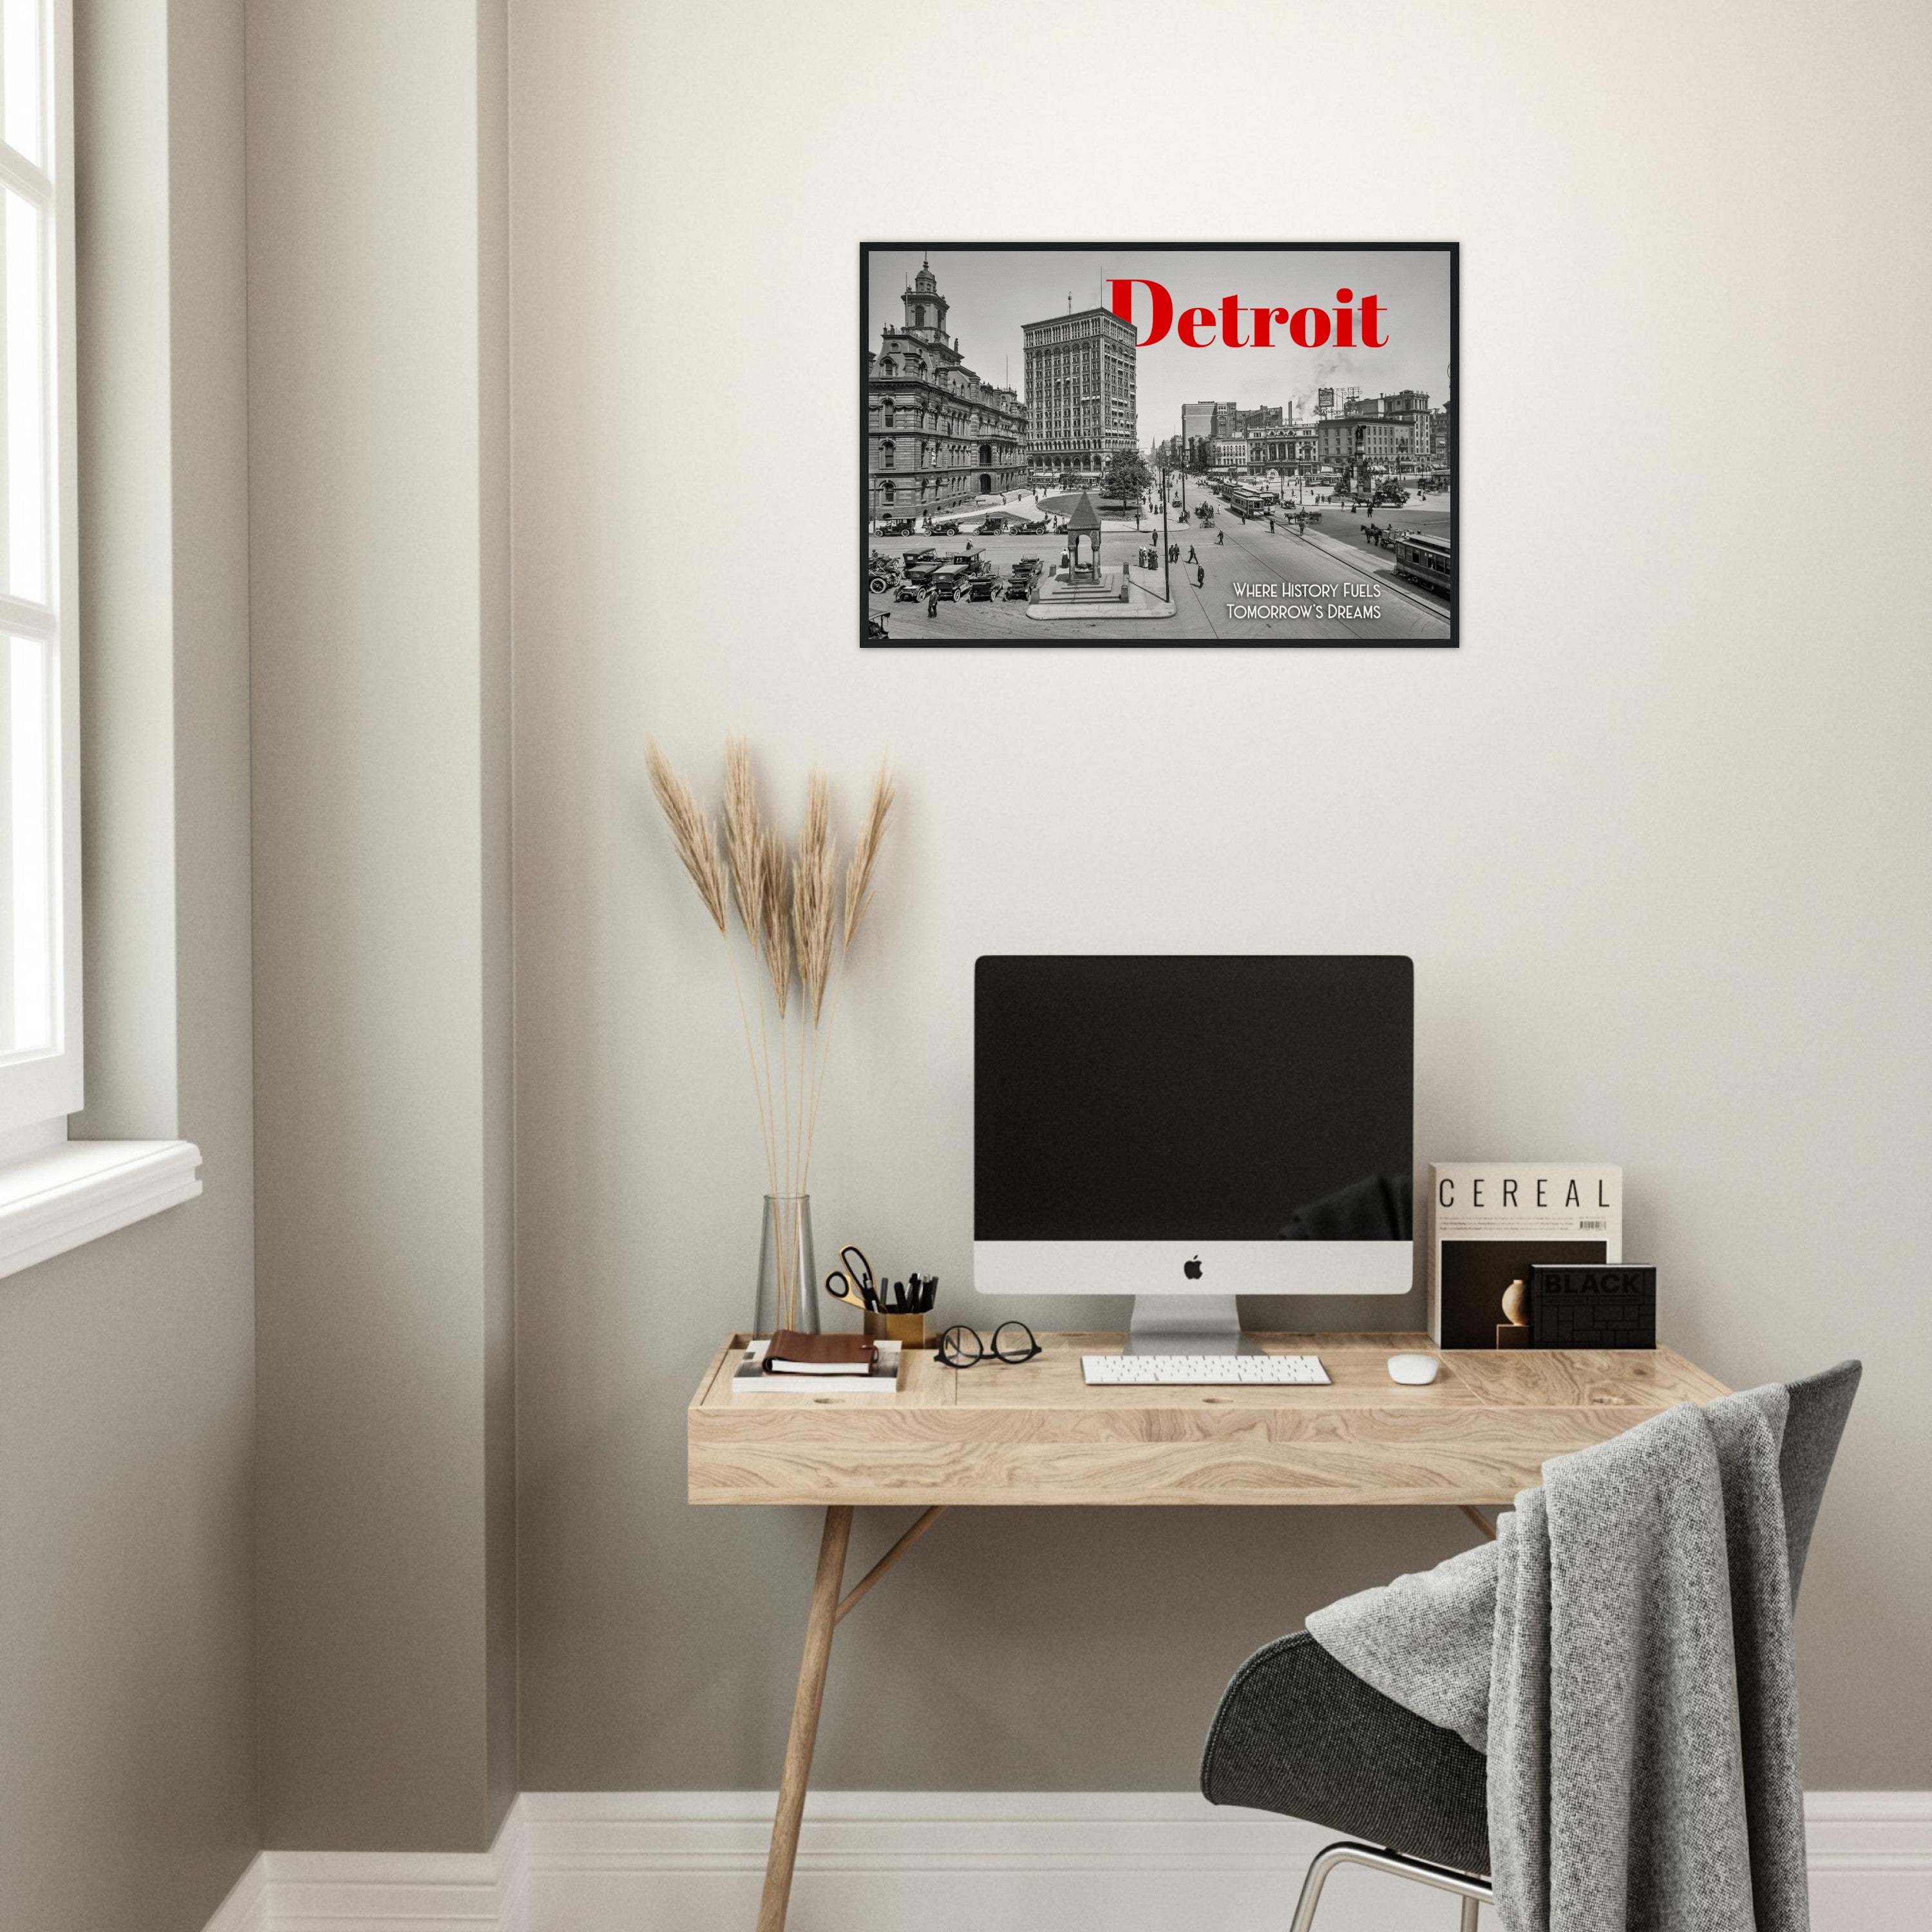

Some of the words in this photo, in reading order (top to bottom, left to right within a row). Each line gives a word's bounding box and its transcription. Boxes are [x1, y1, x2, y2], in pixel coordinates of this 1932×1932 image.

[1106, 279, 1389, 348] Detroit
[1233, 582, 1278, 598] WHERE
[1282, 582, 1339, 598] HISTORY
[1343, 582, 1381, 598] FUELS
[1328, 603, 1381, 619] DREAMS
[1439, 1178, 1610, 1208] CEREAL
[1544, 1273, 1642, 1294] BLACK
